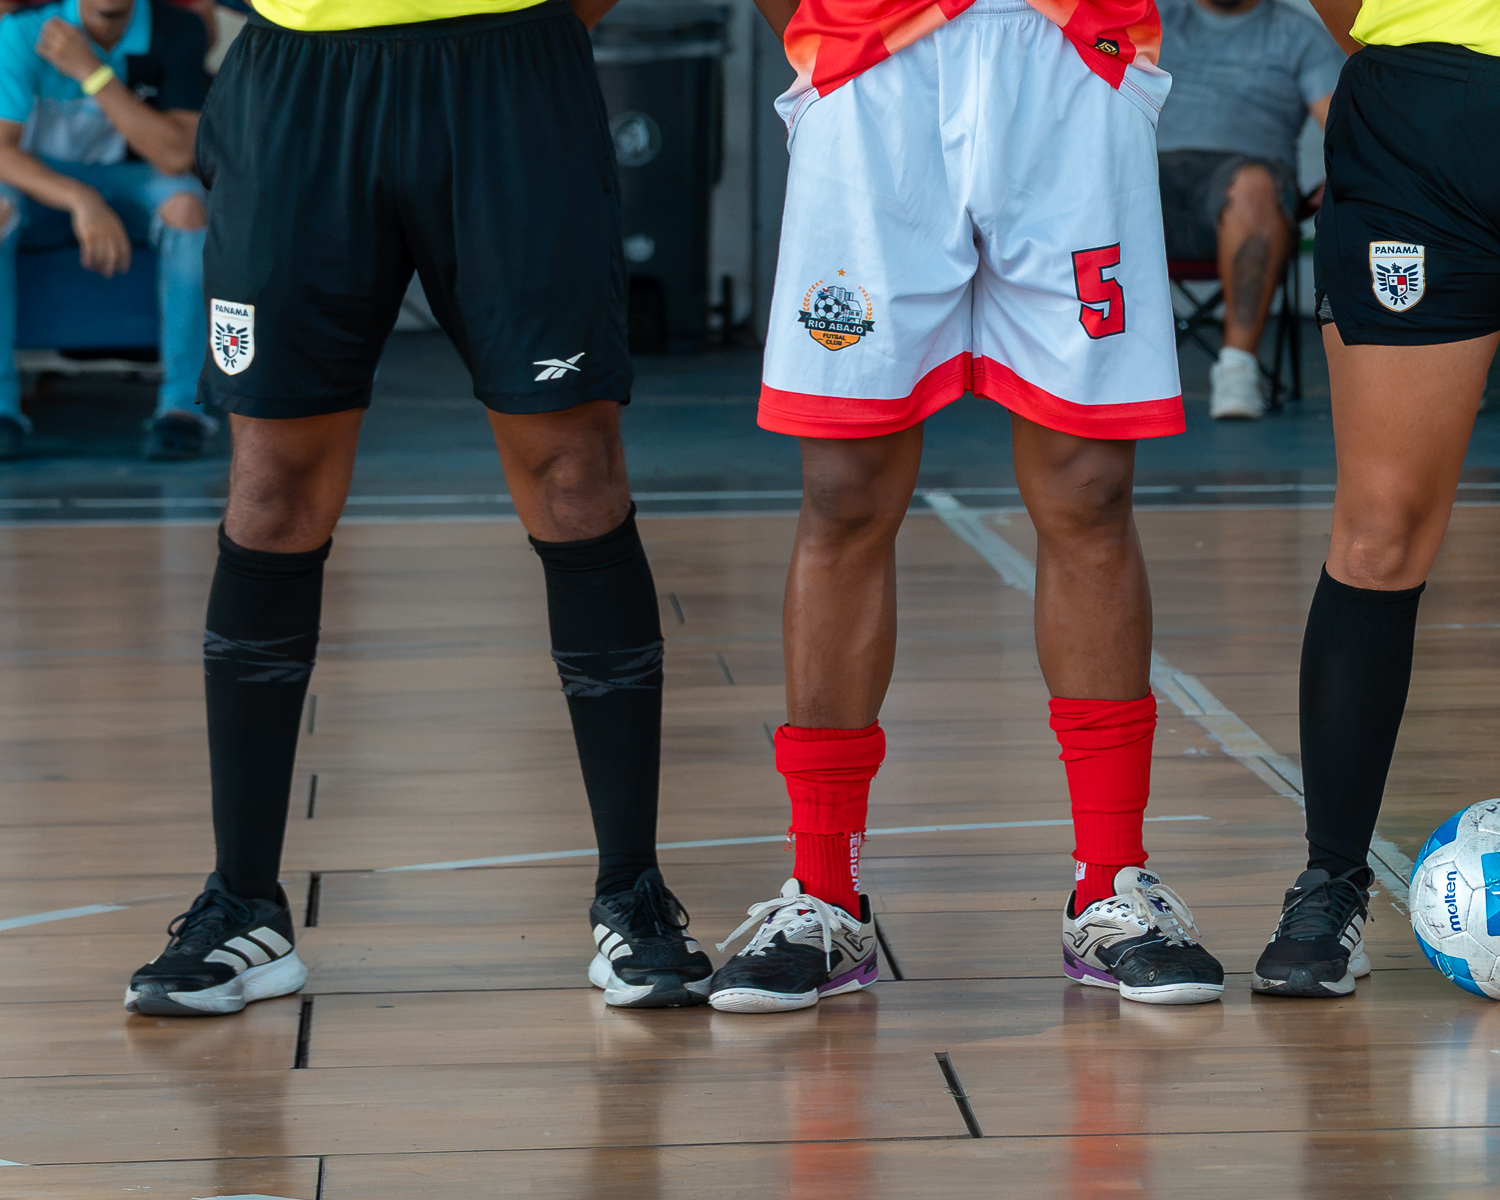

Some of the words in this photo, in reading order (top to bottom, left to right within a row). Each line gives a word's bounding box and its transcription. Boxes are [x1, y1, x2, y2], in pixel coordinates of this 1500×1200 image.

[1071, 241, 1126, 340] 5
[808, 320, 826, 329] RIO
[829, 323, 864, 334] ABAJO
[1444, 870, 1462, 932] molten
